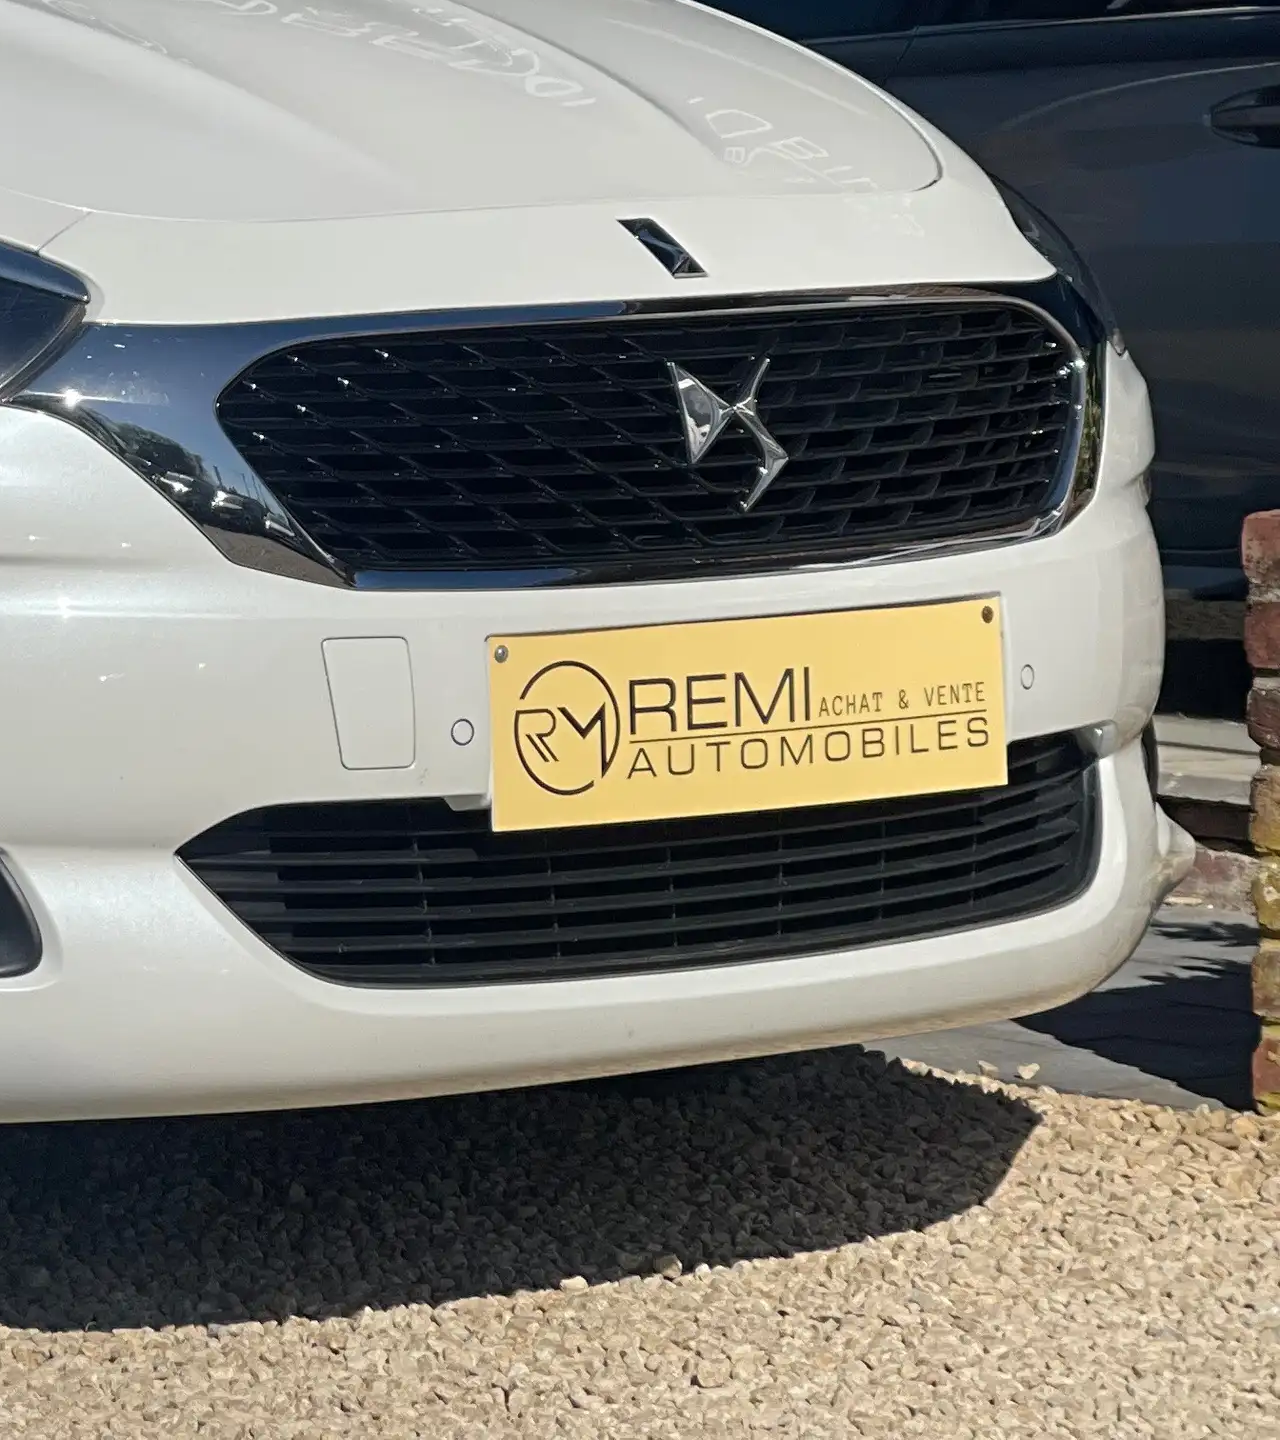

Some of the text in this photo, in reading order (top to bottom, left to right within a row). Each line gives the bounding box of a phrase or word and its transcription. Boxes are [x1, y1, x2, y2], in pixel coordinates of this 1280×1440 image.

[628, 666, 811, 735] REMI
[818, 691, 883, 718] ACHAT
[898, 687, 910, 710] &
[924, 681, 986, 707] VENTE
[627, 716, 990, 780] AUTOMOBILES
